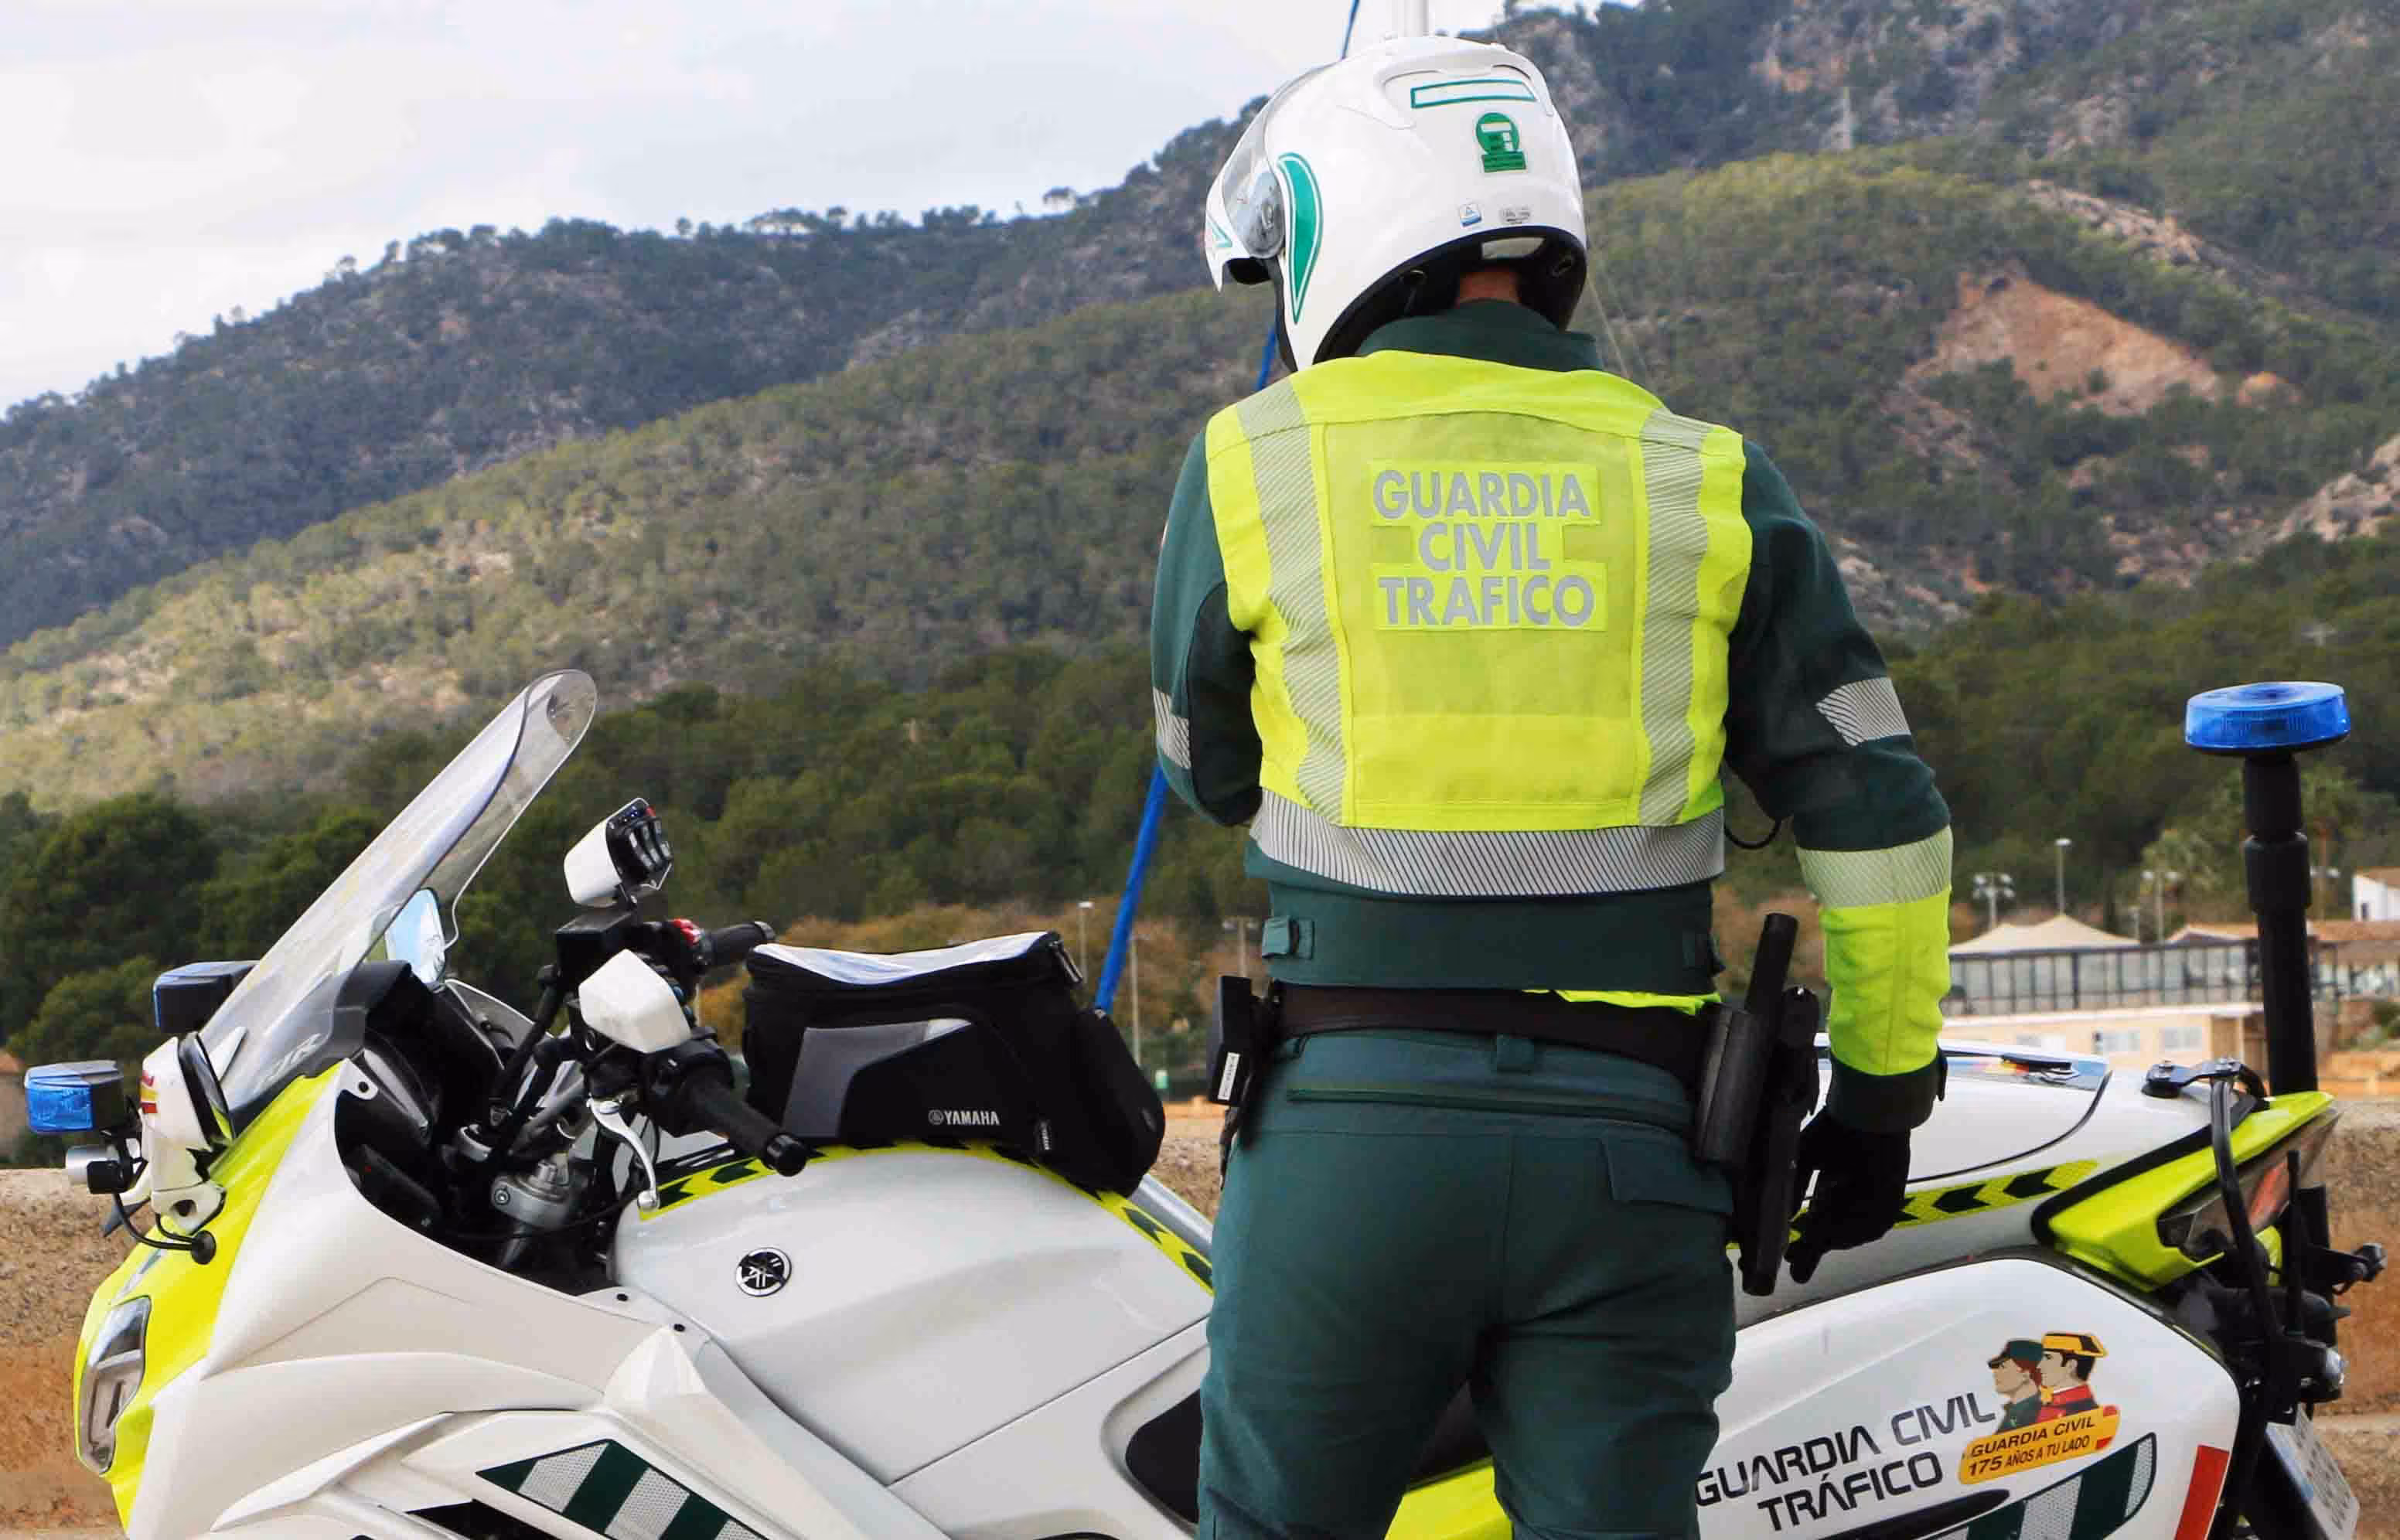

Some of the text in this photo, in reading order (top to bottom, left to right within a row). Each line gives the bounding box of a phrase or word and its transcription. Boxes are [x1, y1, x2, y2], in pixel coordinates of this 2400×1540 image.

[1372, 469, 1591, 520] GUARDIA
[1417, 521, 1551, 572] CIVIL
[1377, 575, 1594, 626] TRAFICO
[943, 1110, 1001, 1126] YAMAHA
[1695, 1392, 1996, 1507] GUARDIA CIVIL
[1969, 1434, 2091, 1477] 175 AÑOS A TU LADO
[1971, 1416, 2095, 1457] GUARDIA CIVIL
[1757, 1451, 1943, 1531] TRÁFICO
